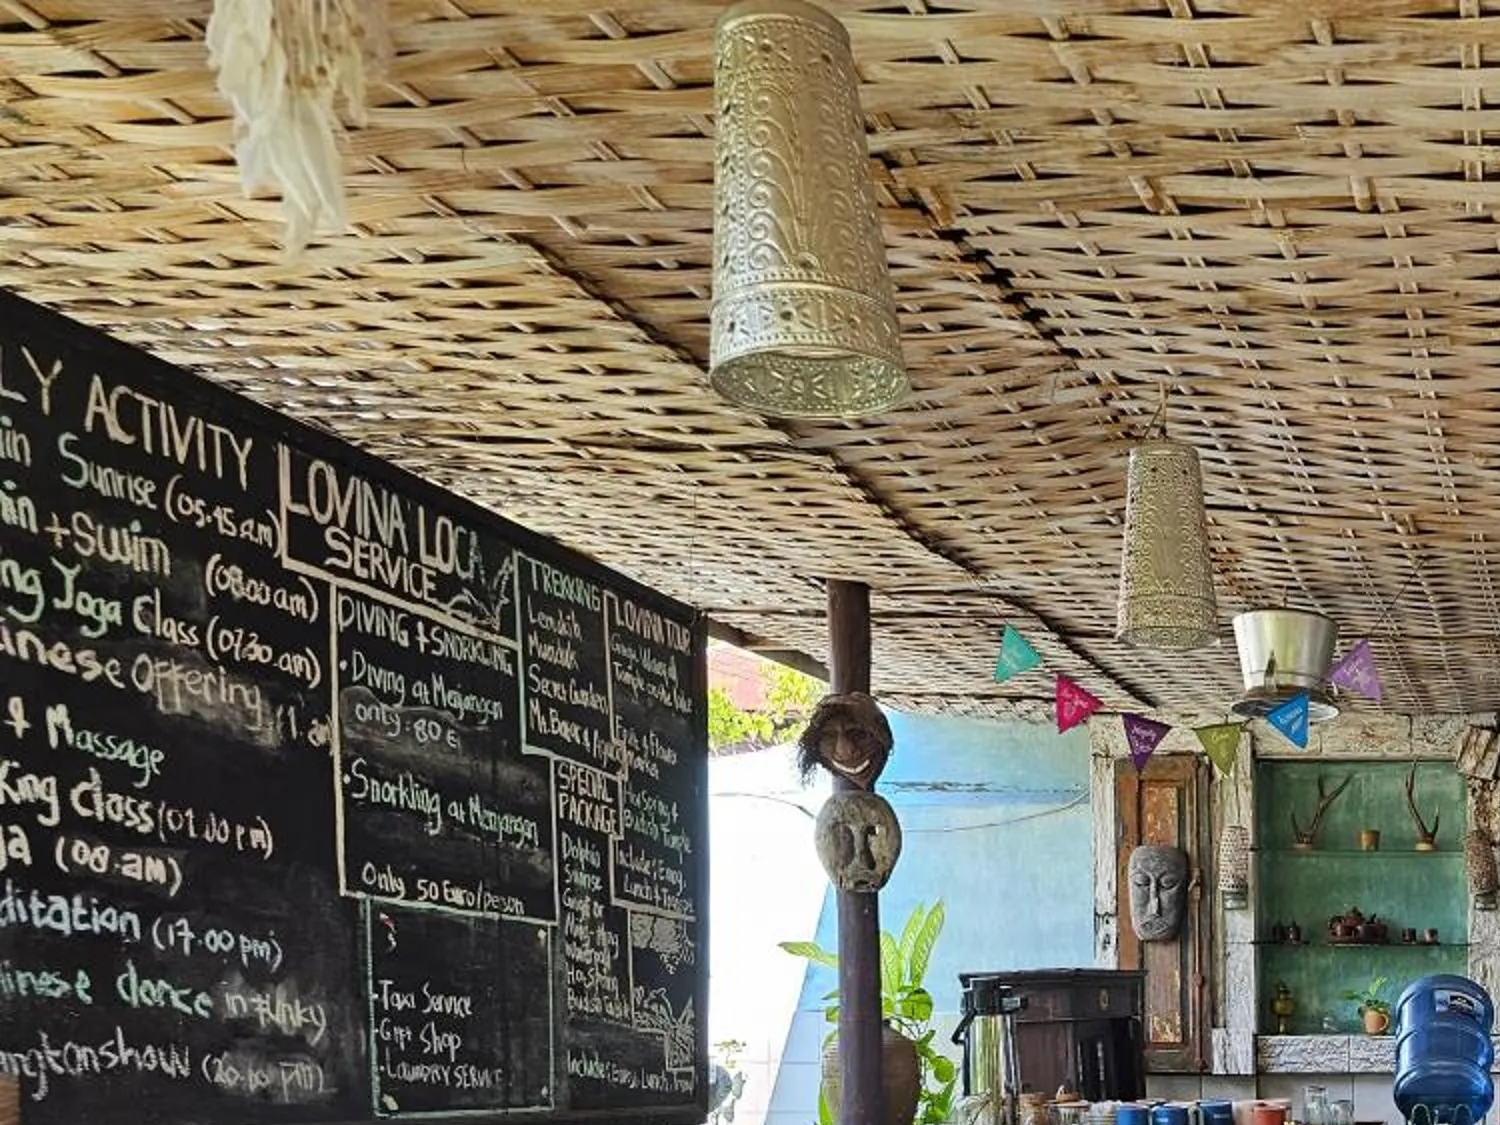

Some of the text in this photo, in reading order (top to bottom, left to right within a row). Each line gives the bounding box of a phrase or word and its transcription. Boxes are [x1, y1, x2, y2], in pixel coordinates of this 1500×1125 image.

[84, 373, 252, 490] ACTIVITY
[58, 432, 157, 509] Sunrise
[277, 442, 409, 554] LOVINA
[324, 526, 437, 603] SERVICE
[51, 556, 122, 638] Yoga
[132, 588, 199, 646] Class
[338, 591, 410, 647] DIVING
[351, 650, 405, 705] Diving
[45, 704, 164, 788] Massage
[559, 793, 617, 838] PACKAGE
[417, 879, 439, 901] 50
[378, 979, 416, 1011] Taxi
[420, 1021, 462, 1063] Shop
